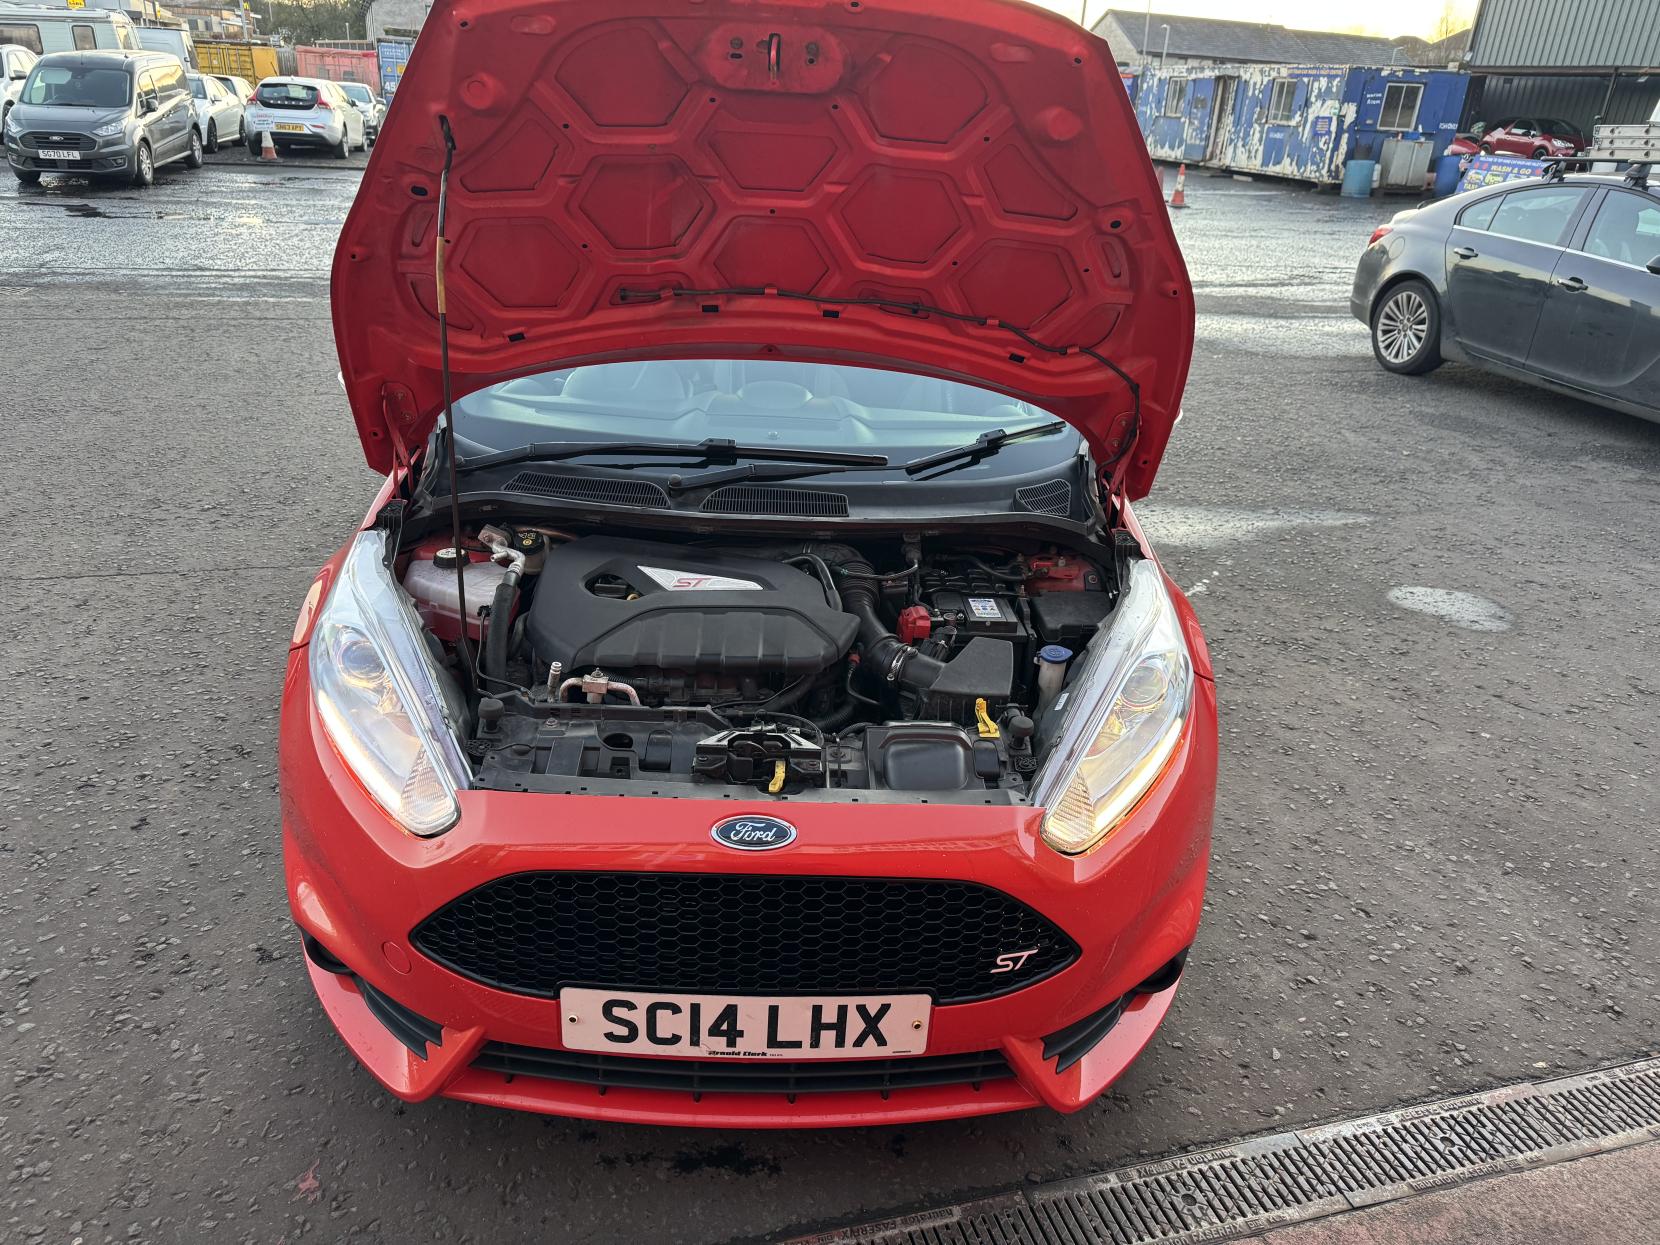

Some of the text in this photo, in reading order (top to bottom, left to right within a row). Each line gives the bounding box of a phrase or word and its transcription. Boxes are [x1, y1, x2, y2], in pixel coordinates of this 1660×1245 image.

[41, 150, 61, 158] SG70
[1519, 167, 1531, 175] GO
[672, 578, 712, 588] ST
[730, 821, 777, 841] Ford
[989, 949, 1039, 974] ST
[602, 999, 892, 1049] SC14 LHX
[1191, 1221, 1244, 1244] FASERFIX
